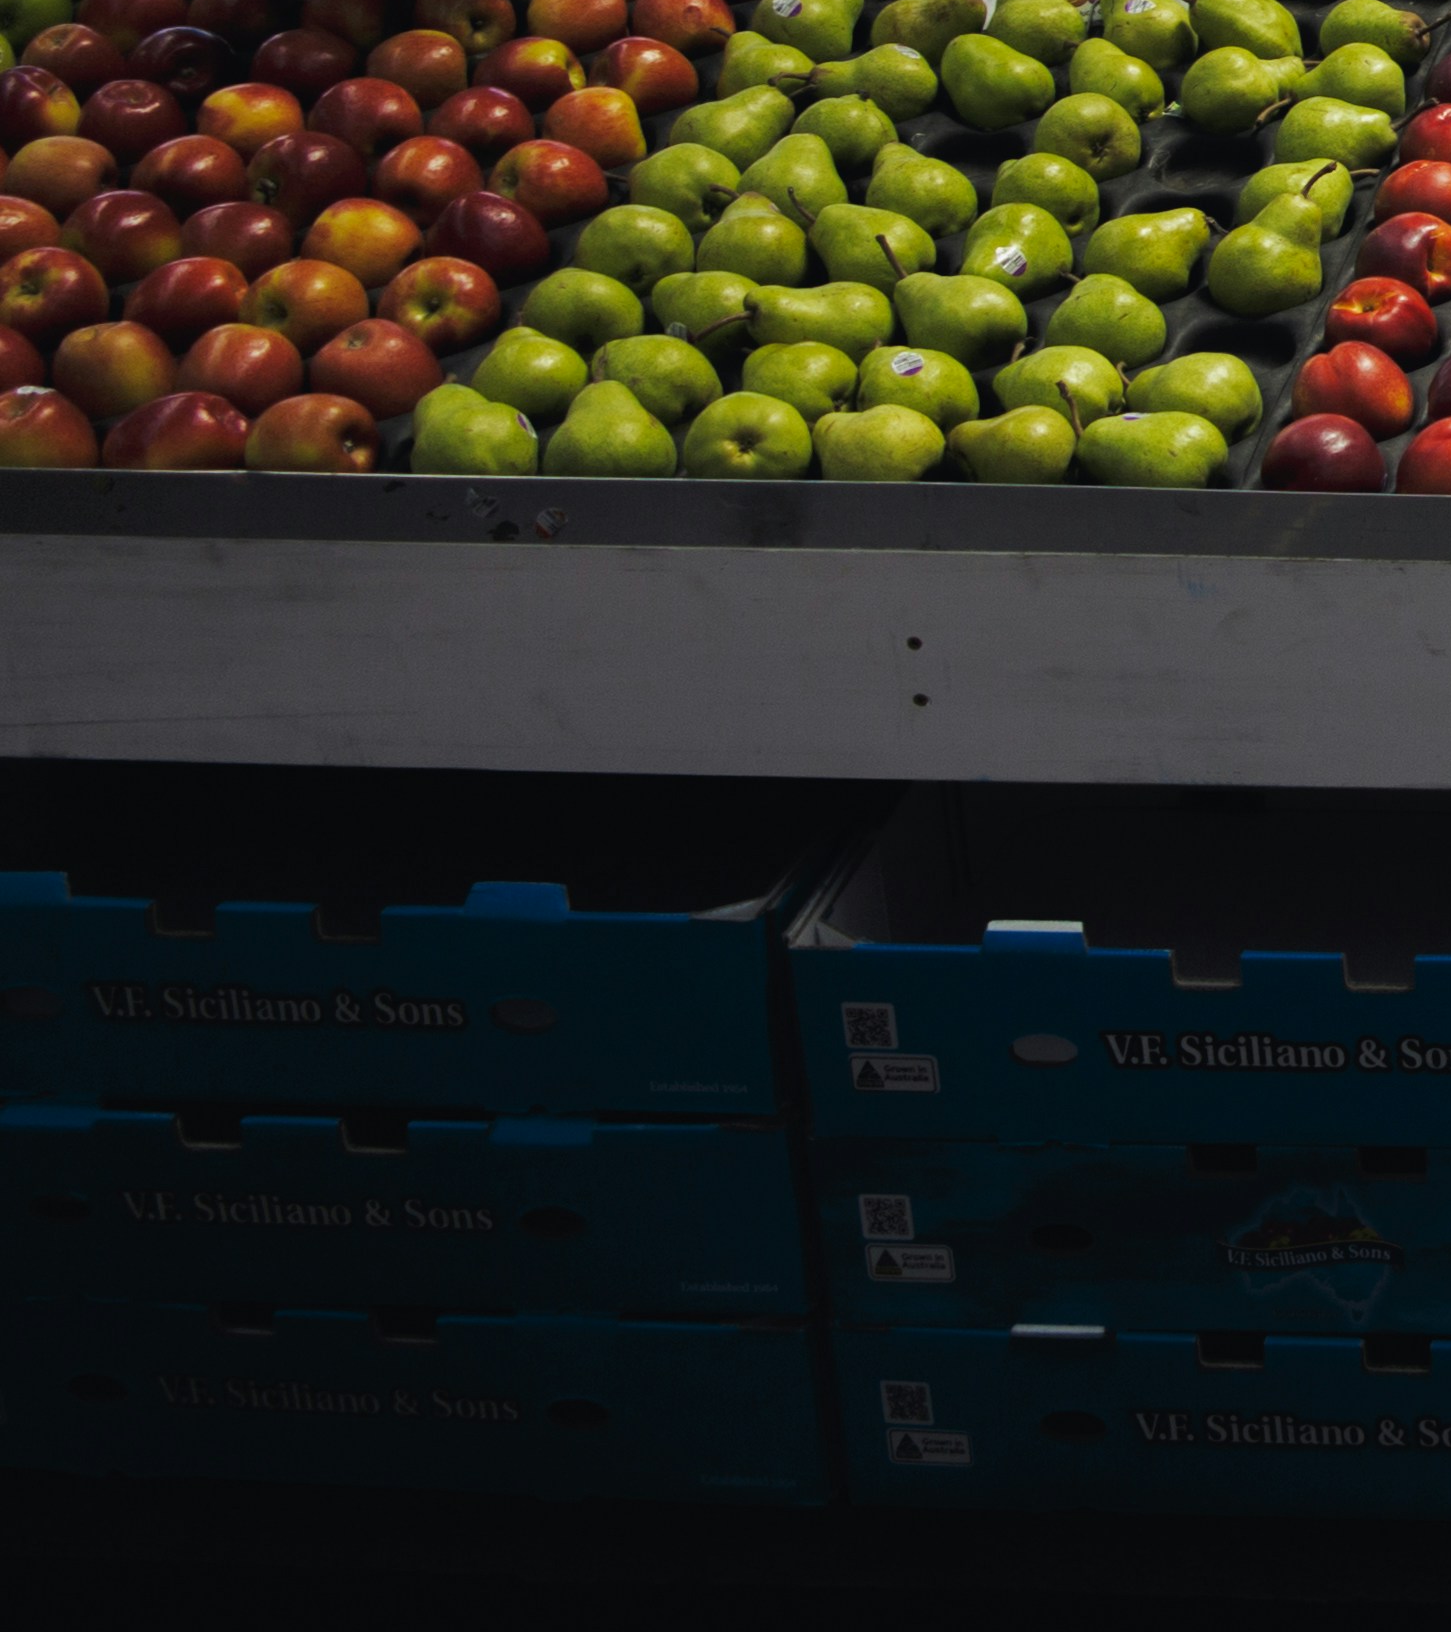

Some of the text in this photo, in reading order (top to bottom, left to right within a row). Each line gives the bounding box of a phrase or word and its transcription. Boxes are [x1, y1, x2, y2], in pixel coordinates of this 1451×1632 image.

[92, 986, 464, 1026] V.F. Siciliano & Sons
[1106, 1034, 1168, 1065] V.F.
[1180, 1035, 1346, 1068] Siciliano
[1358, 1039, 1387, 1069] &
[884, 1064, 928, 1074] Grown in
[884, 1072, 929, 1083] Australia
[123, 1192, 494, 1230] V.F. Siciliano & Sons
[1254, 1248, 1328, 1268] Siciliano
[1330, 1246, 1345, 1261] &
[1347, 1243, 1392, 1261] Sons
[225, 1380, 381, 1414] Siciliano
[431, 1390, 519, 1421] Sons
[1135, 1413, 1195, 1441] V.F.
[1206, 1414, 1365, 1446] Siciliano
[1377, 1419, 1405, 1447] &
